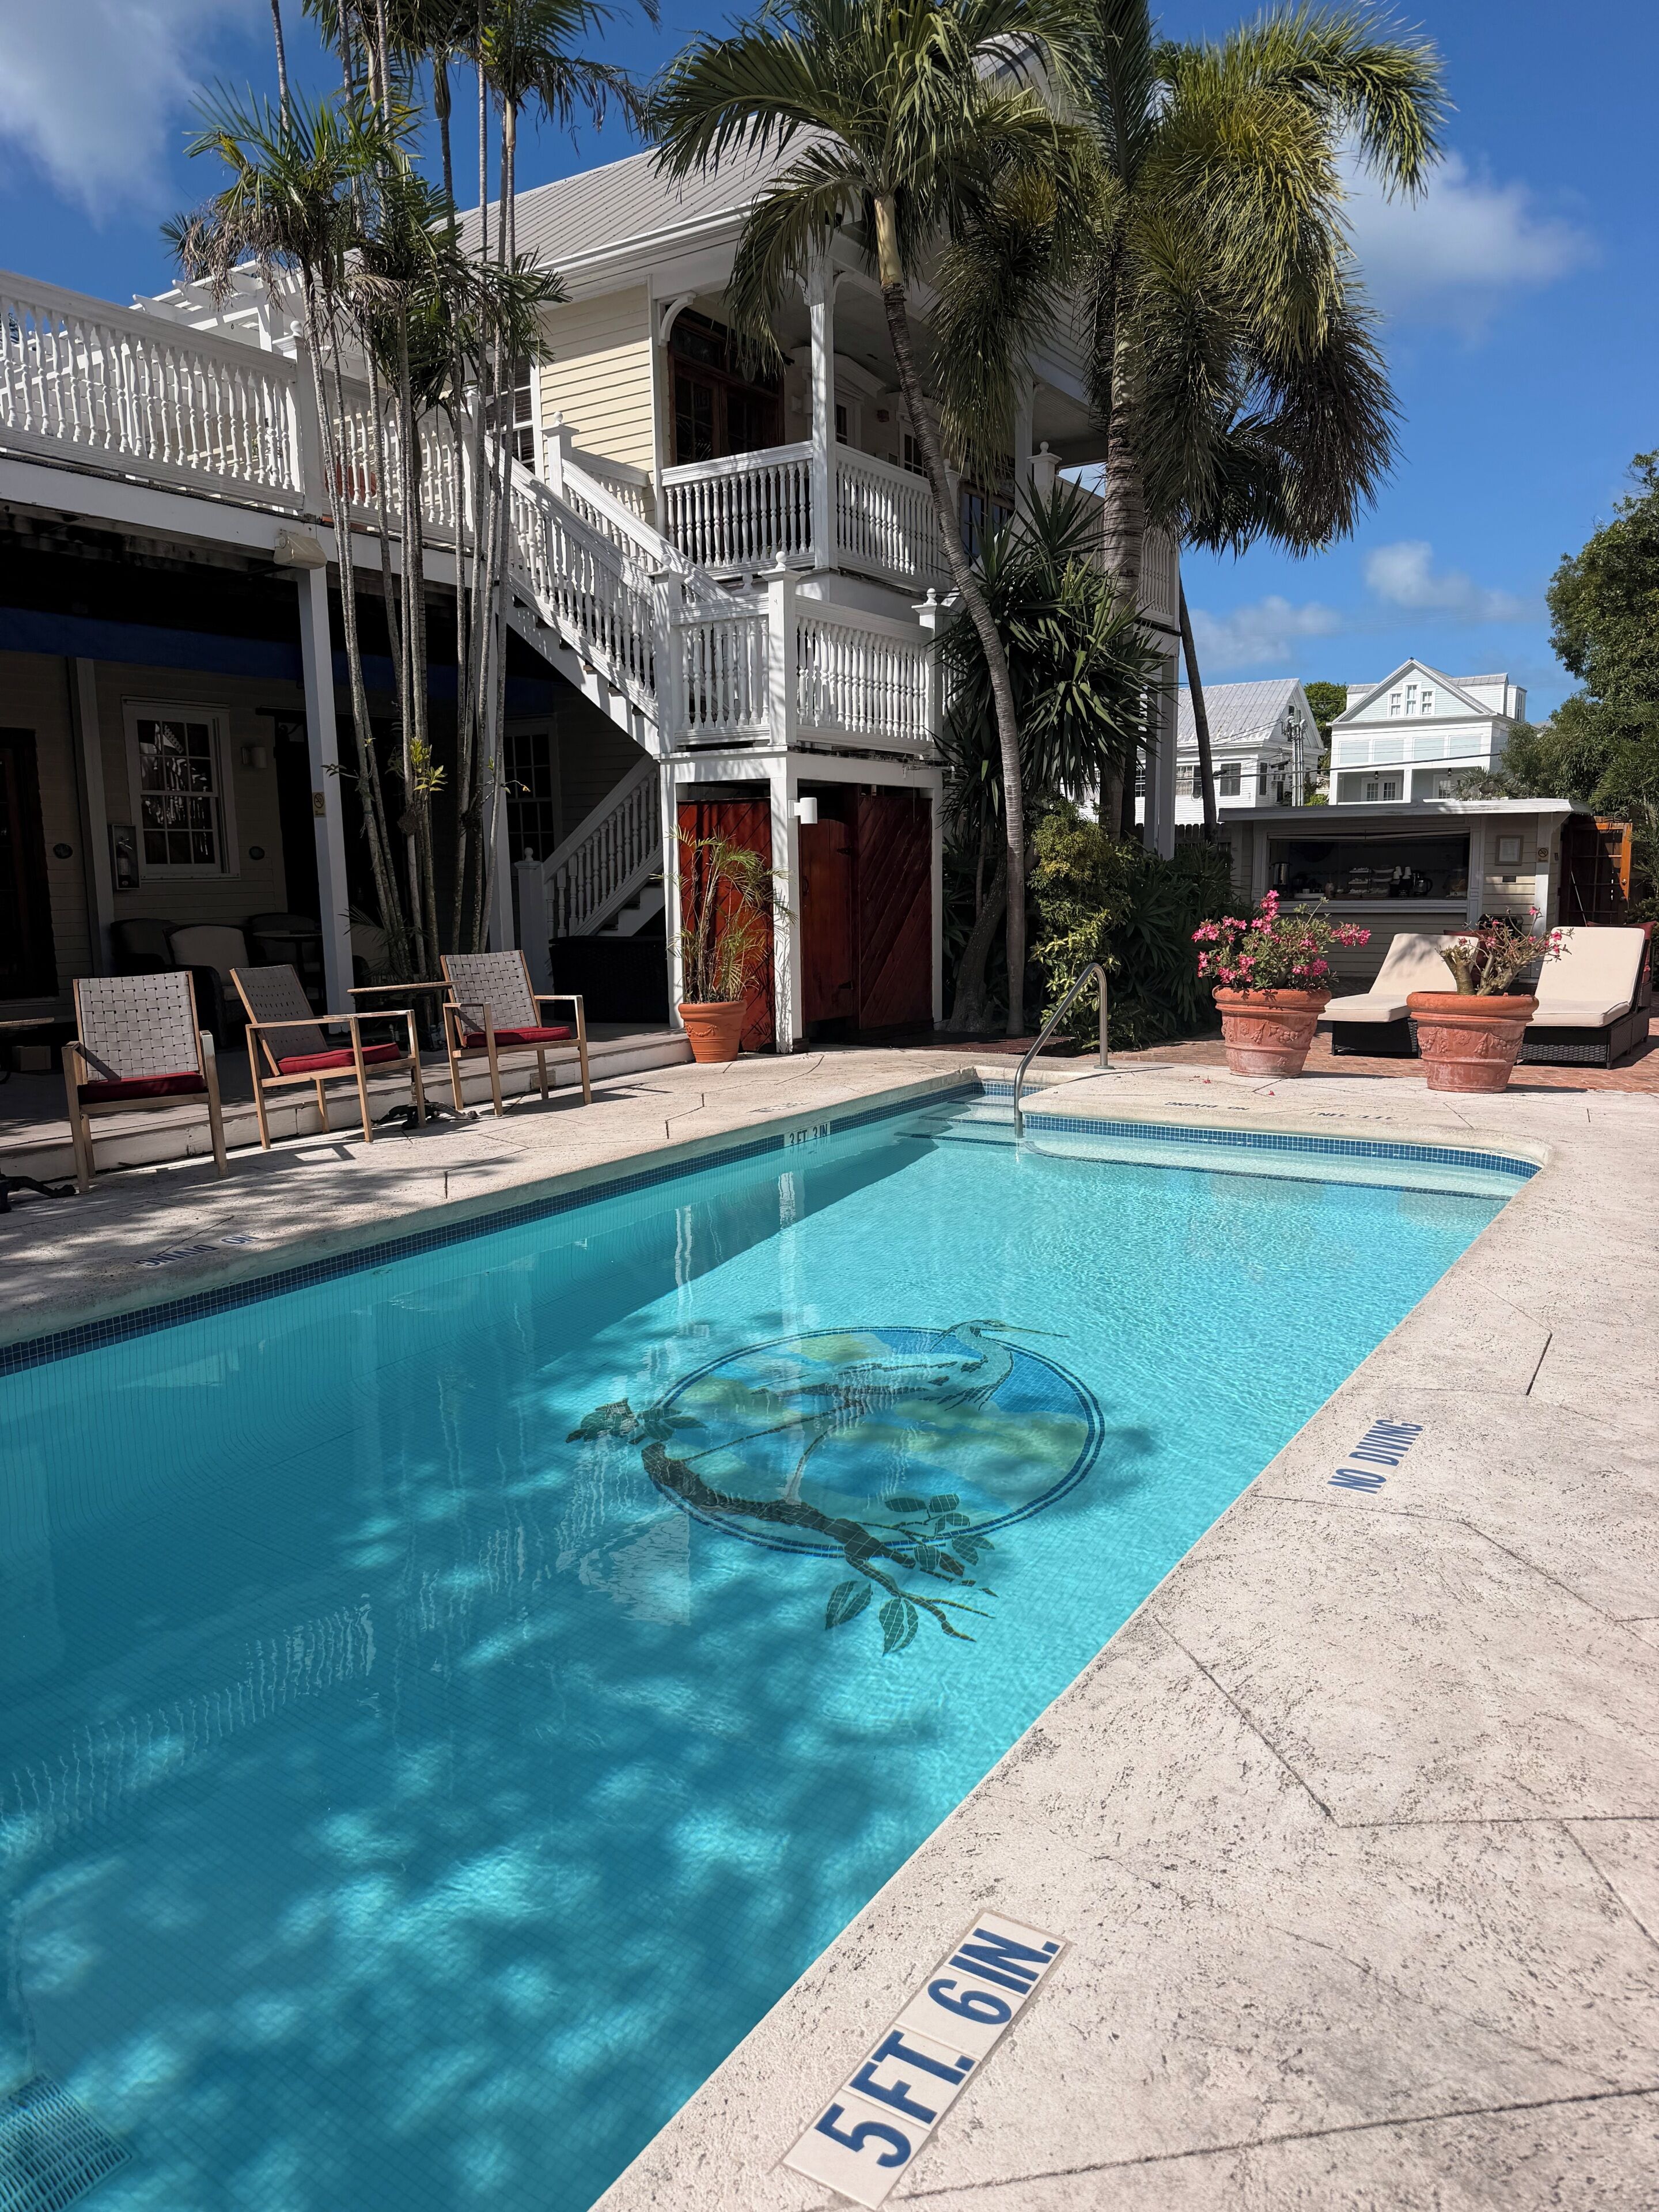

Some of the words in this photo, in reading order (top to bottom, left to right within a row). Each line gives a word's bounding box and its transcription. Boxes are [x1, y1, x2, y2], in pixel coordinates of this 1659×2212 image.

[132, 1244, 219, 1266] DIVING
[221, 1234, 260, 1244] NO
[1348, 1419, 1424, 1467] DIVING
[1327, 1468, 1387, 1494] NO
[849, 2029, 976, 2125] FT.
[814, 2103, 912, 2168] 5
